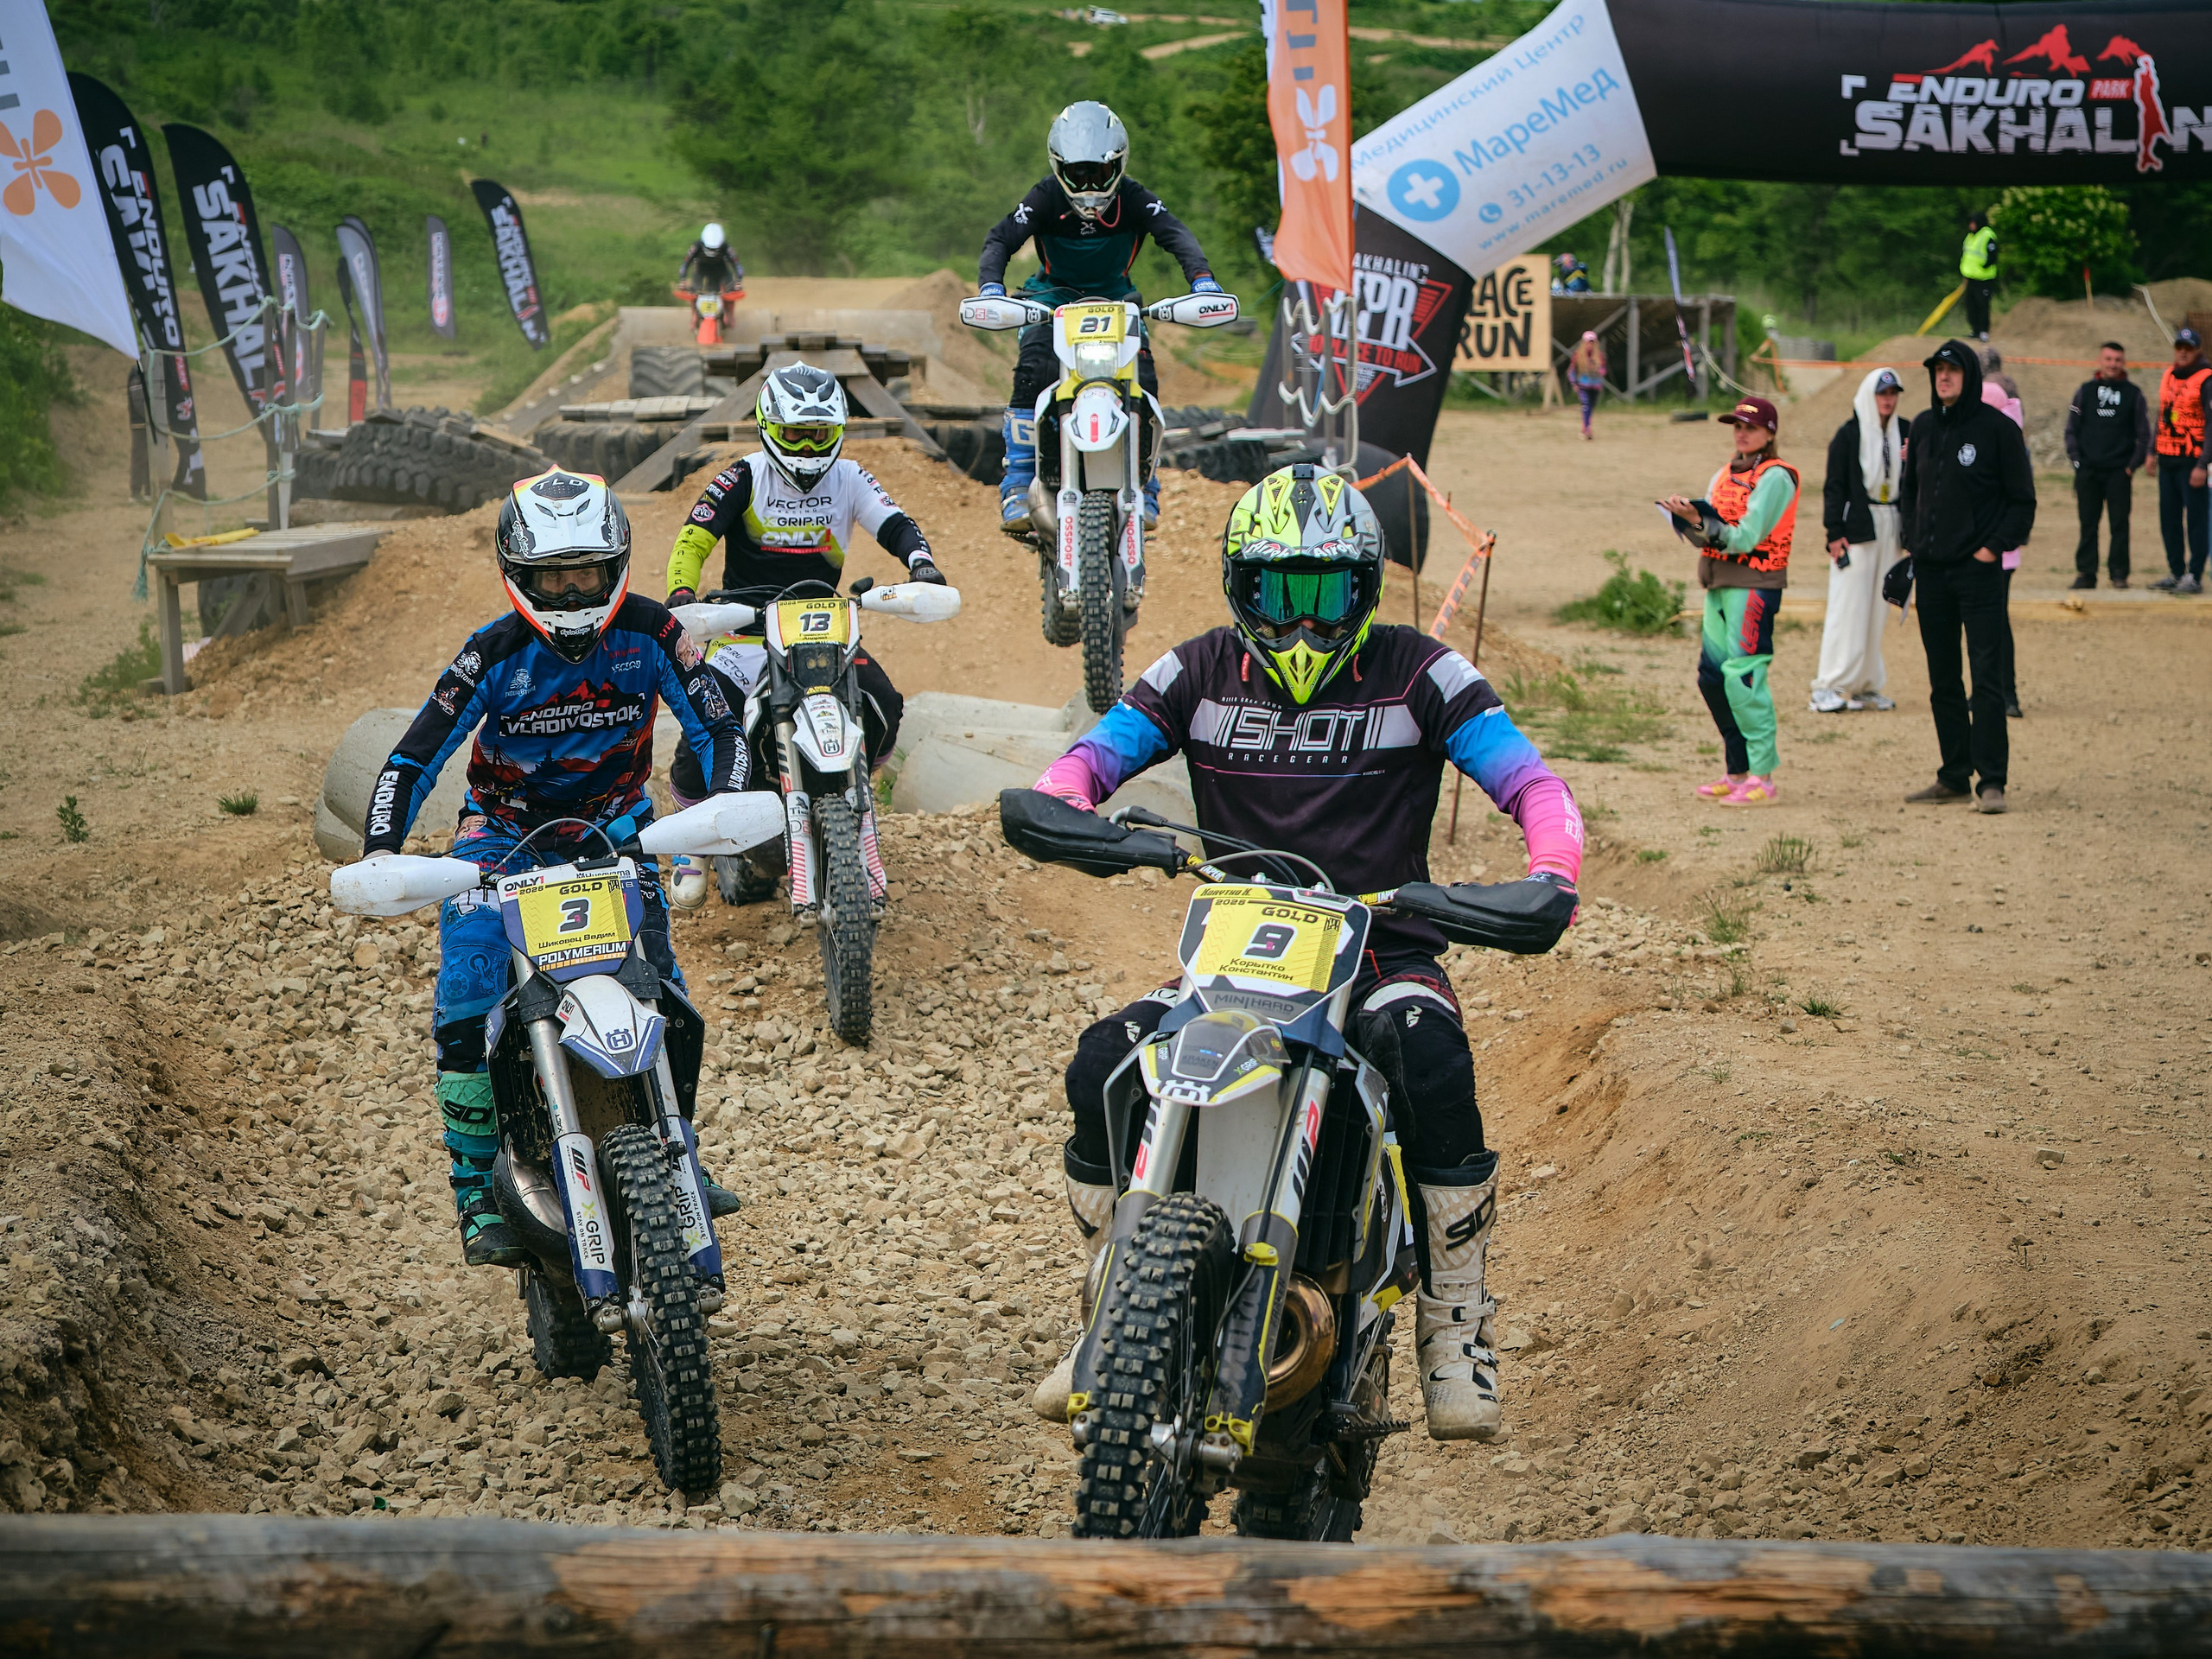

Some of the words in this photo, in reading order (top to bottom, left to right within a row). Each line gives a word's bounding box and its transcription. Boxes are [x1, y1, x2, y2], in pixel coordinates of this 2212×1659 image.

[1514, 14, 1586, 71] Центр
[1887, 73, 2085, 107] ENDURO
[2092, 79, 2131, 99] PARK
[1453, 67, 1622, 176] МареМед
[1507, 143, 1601, 208] 31-13-13
[1478, 157, 1628, 251] www.maremed.ru
[130, 169, 180, 346] ENDURO
[1353, 252, 1422, 281] AKHALIN
[1469, 267, 1534, 318] LACE
[1080, 315, 1111, 334] 21
[537, 478, 584, 491] TLD
[767, 496, 832, 509] VECTOR
[761, 528, 831, 546] ONLY1
[1244, 540, 1291, 559] Airoh
[1313, 540, 1357, 559] Airoh
[799, 612, 831, 632] 13
[713, 652, 750, 686] VECTOR
[506, 705, 642, 734] VLADIVOSTOK
[519, 701, 594, 721] ENDURO
[1230, 706, 1366, 751] SHOT
[370, 771, 400, 836] ENDURO
[504, 875, 544, 893] ONLY1
[519, 885, 544, 895] 2026
[559, 881, 603, 895] GOLD
[558, 899, 590, 933] 3
[1262, 906, 1319, 924] GOLD
[538, 937, 582, 949] Шиковец
[583, 931, 615, 944] Вадим
[1244, 924, 1295, 958] 9
[538, 942, 626, 966] POLYMERIUM
[1230, 957, 1286, 971] Корытко
[1218, 964, 1294, 981] Константин
